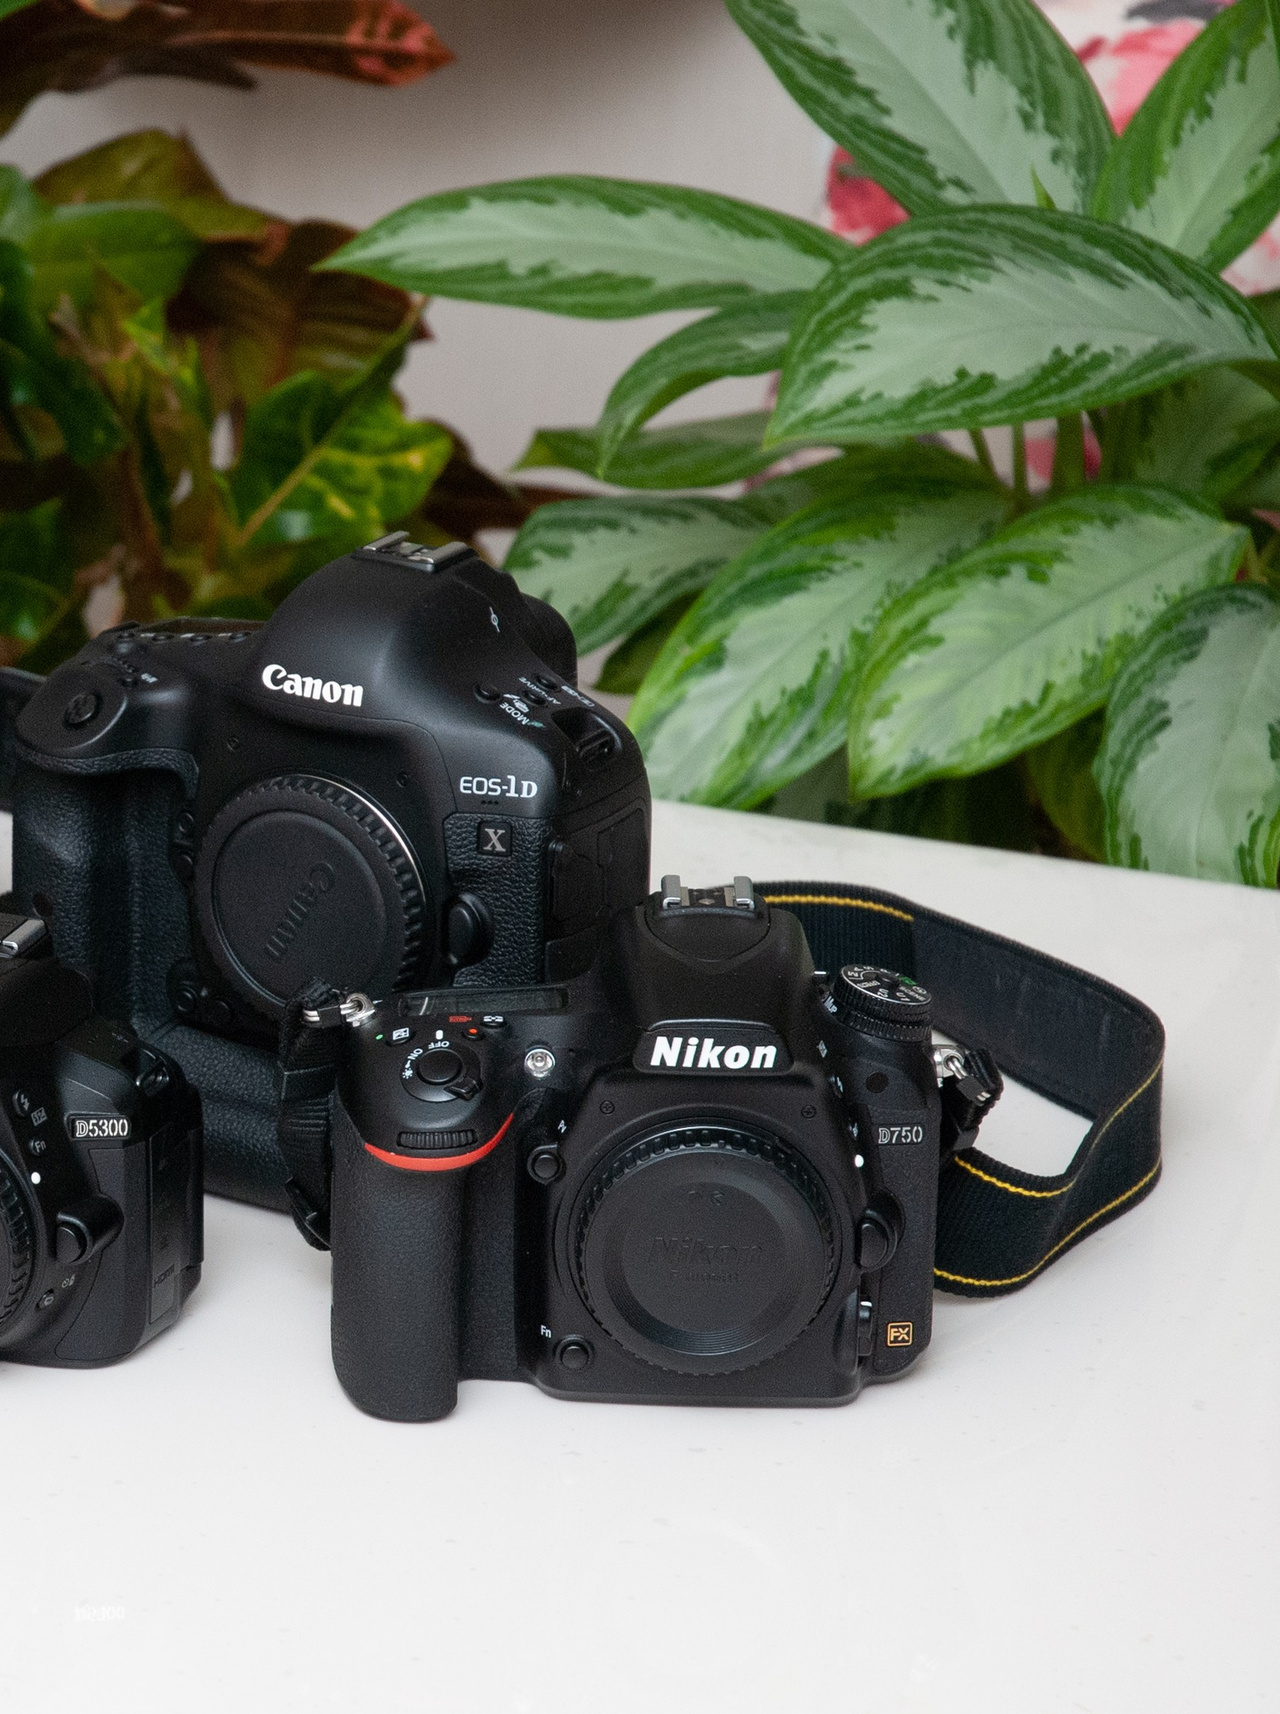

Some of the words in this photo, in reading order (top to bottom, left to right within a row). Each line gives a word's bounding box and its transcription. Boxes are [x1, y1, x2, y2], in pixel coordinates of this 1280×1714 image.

[261, 663, 364, 707] Canon
[499, 701, 530, 726] MODE
[482, 828, 506, 852] X
[407, 1047, 424, 1060] ON
[428, 1040, 450, 1050] OFF
[649, 1035, 778, 1069] Nikon
[75, 1118, 129, 1138] D5300
[877, 1126, 923, 1144] D750
[34, 1140, 47, 1154] Fn
[540, 1324, 552, 1339] Fn
[890, 1327, 910, 1342] FX
